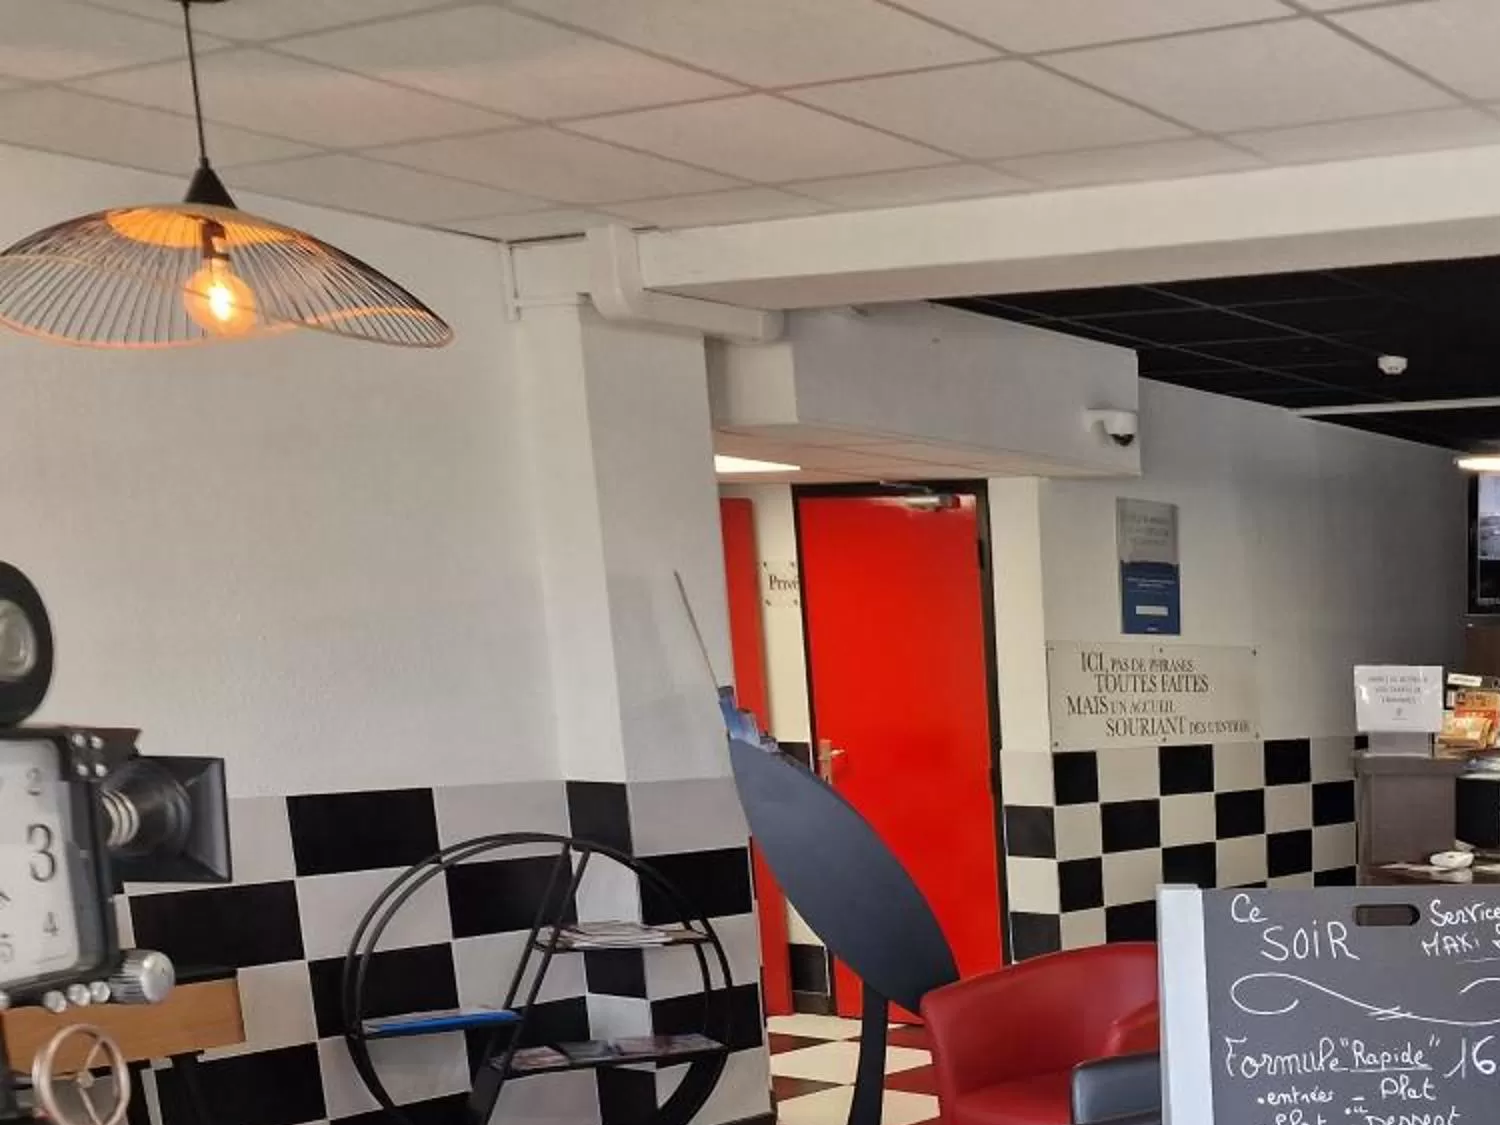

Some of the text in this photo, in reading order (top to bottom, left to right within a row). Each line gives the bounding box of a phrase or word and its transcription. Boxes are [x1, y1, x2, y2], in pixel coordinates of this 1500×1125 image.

[1094, 673, 1209, 693] TOUTES FAITES
[1067, 695, 1108, 715] MAIS
[1105, 716, 1186, 737] SOURIANT
[27, 823, 57, 883] 3
[1231, 894, 1268, 924] Ce
[43, 911, 59, 936] 4
[1224, 1036, 1342, 1079] Formule
[1380, 1074, 1437, 1101] Plat
